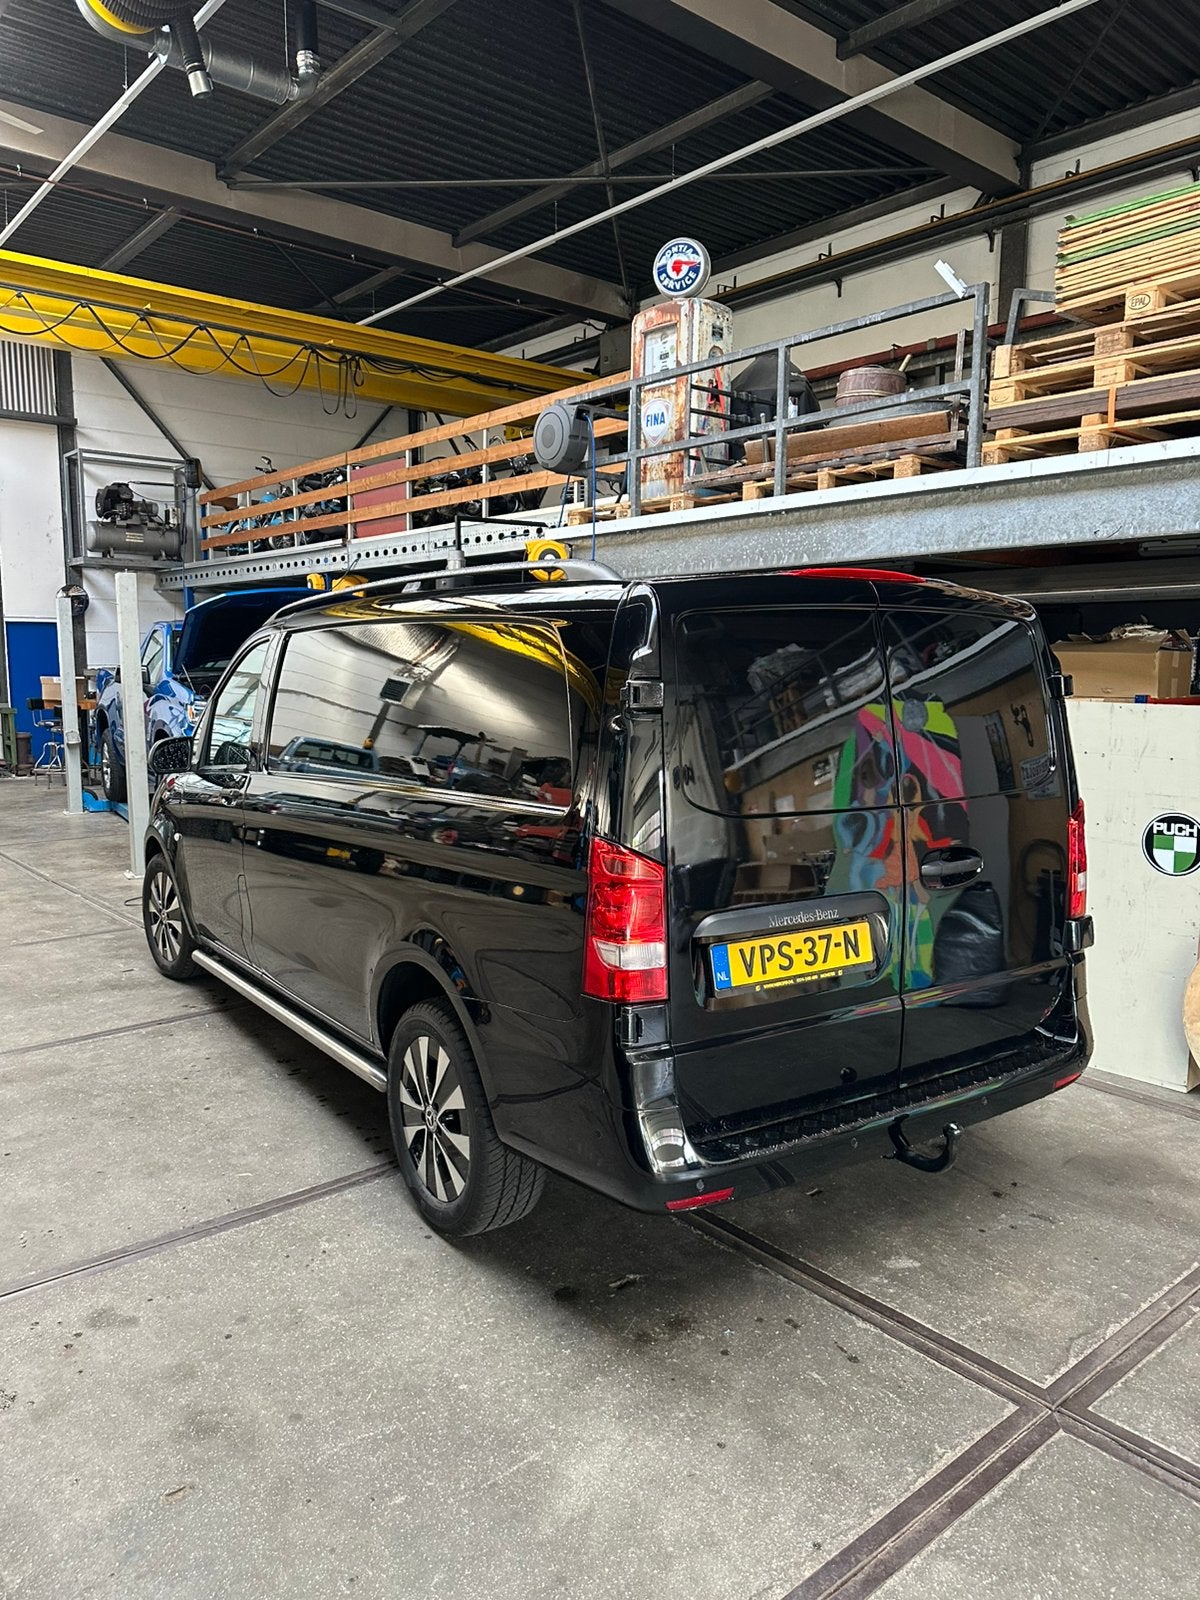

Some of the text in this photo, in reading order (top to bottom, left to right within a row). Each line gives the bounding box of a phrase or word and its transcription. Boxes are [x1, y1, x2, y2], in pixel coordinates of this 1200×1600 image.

[660, 270, 697, 290] SERVICE
[1131, 296, 1147, 308] EPAL
[646, 411, 666, 428] FINA
[1153, 822, 1198, 837] PUCH
[769, 908, 839, 928] Mercedes-Benz
[739, 929, 860, 978] VPS-37-N
[717, 971, 729, 982] NL
